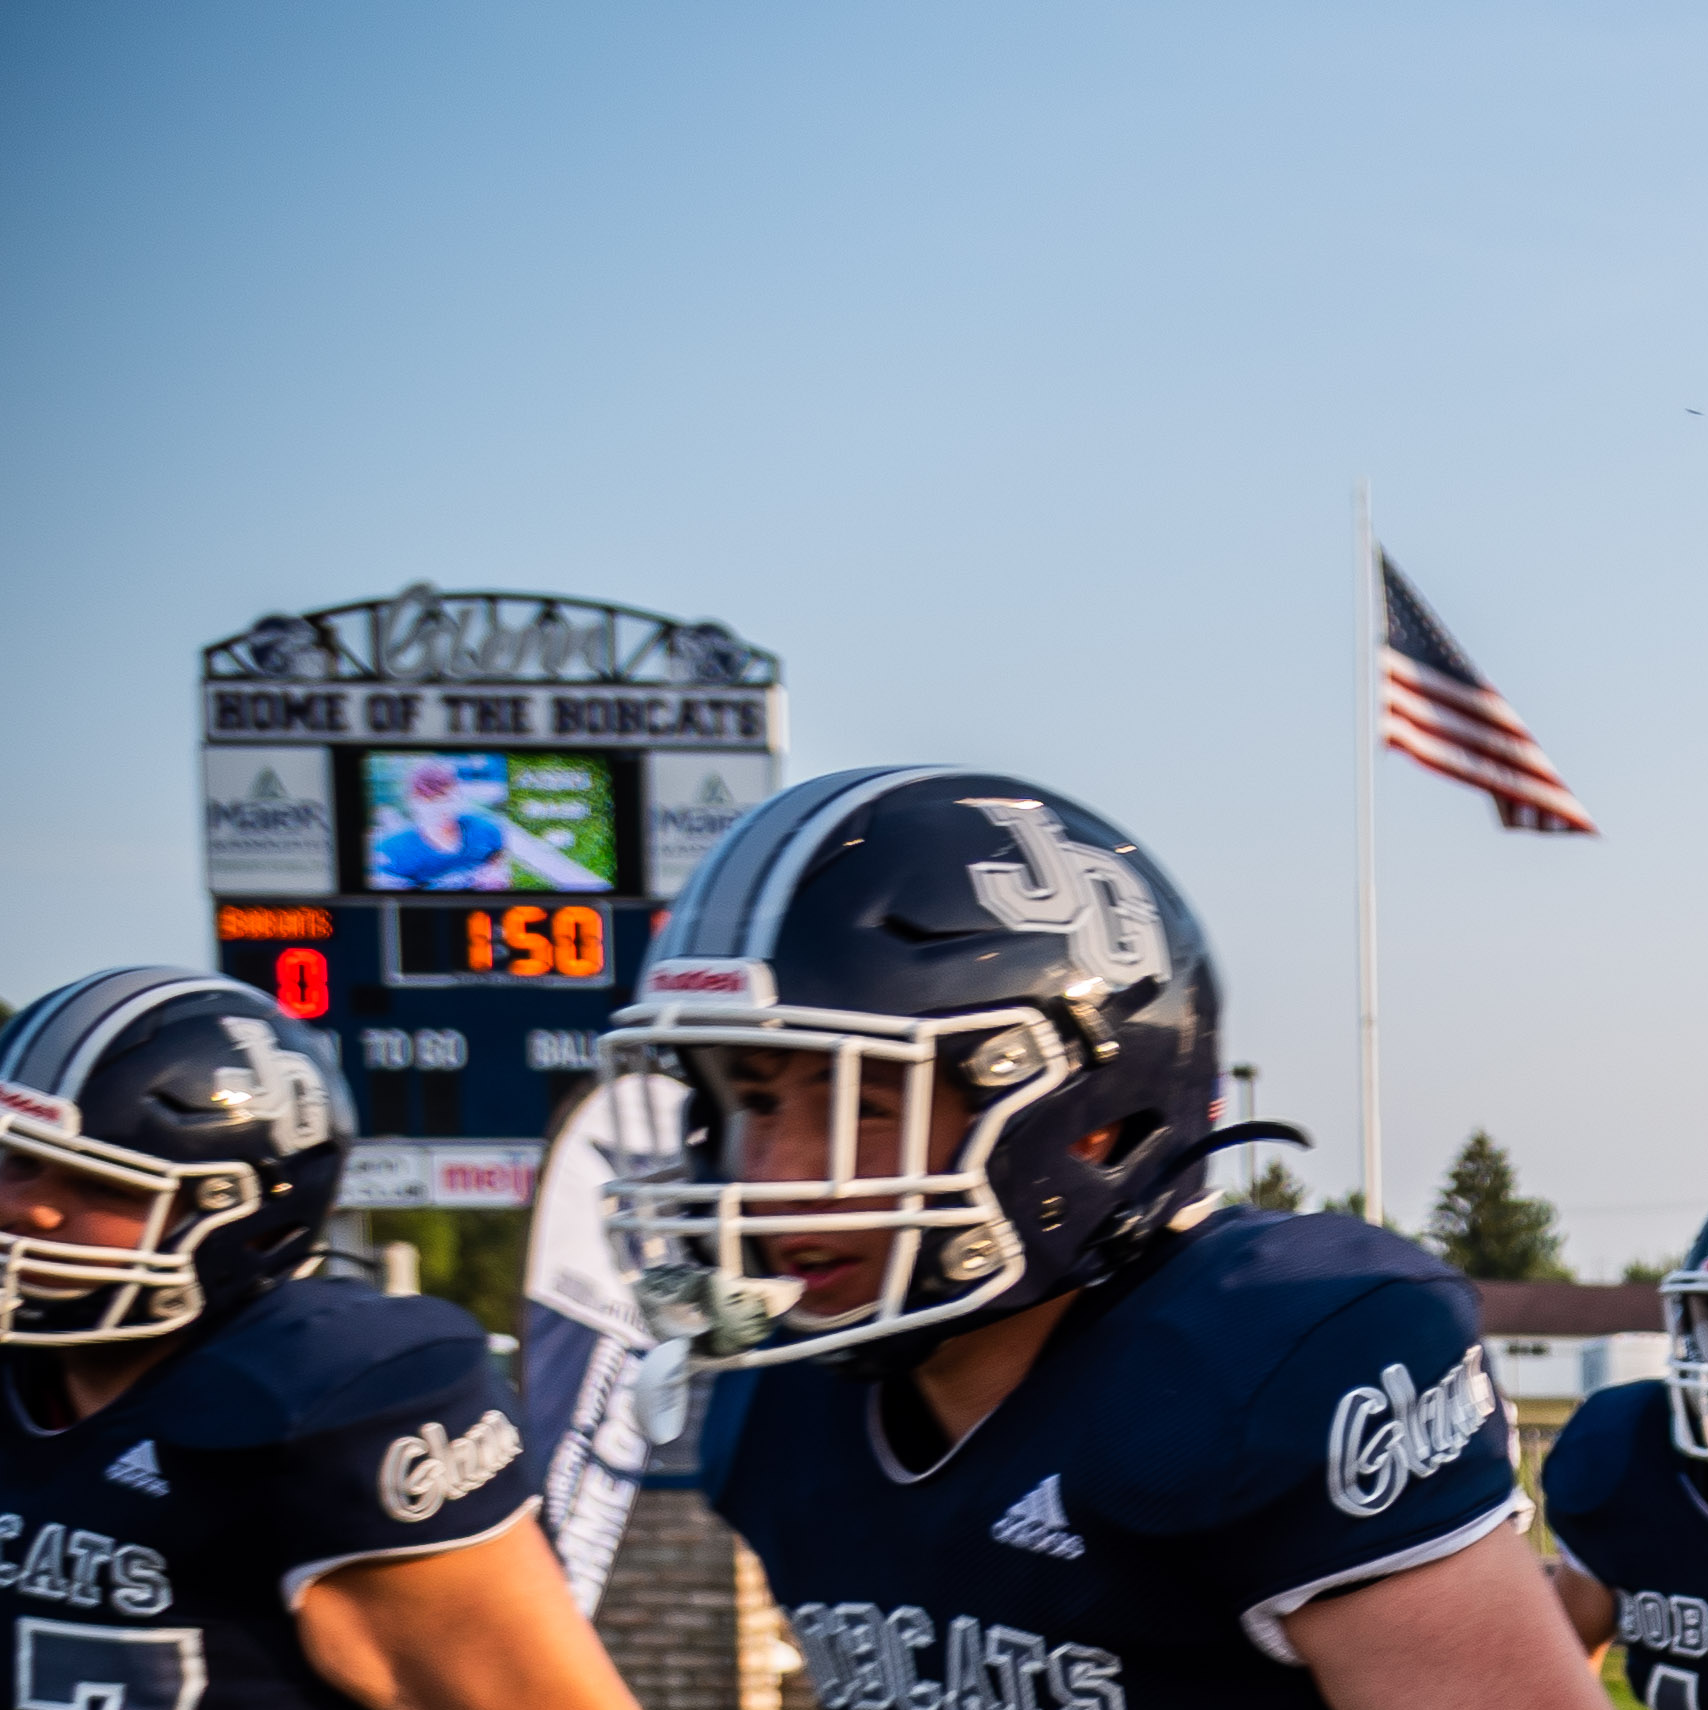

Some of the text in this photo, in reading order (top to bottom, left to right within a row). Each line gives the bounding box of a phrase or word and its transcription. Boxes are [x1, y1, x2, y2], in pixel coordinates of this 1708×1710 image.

[214, 691, 764, 738] HOME OF THE BOBCATS
[276, 947, 329, 1019] 0
[363, 1027, 413, 1071] TO
[440, 1151, 538, 1205] meij
